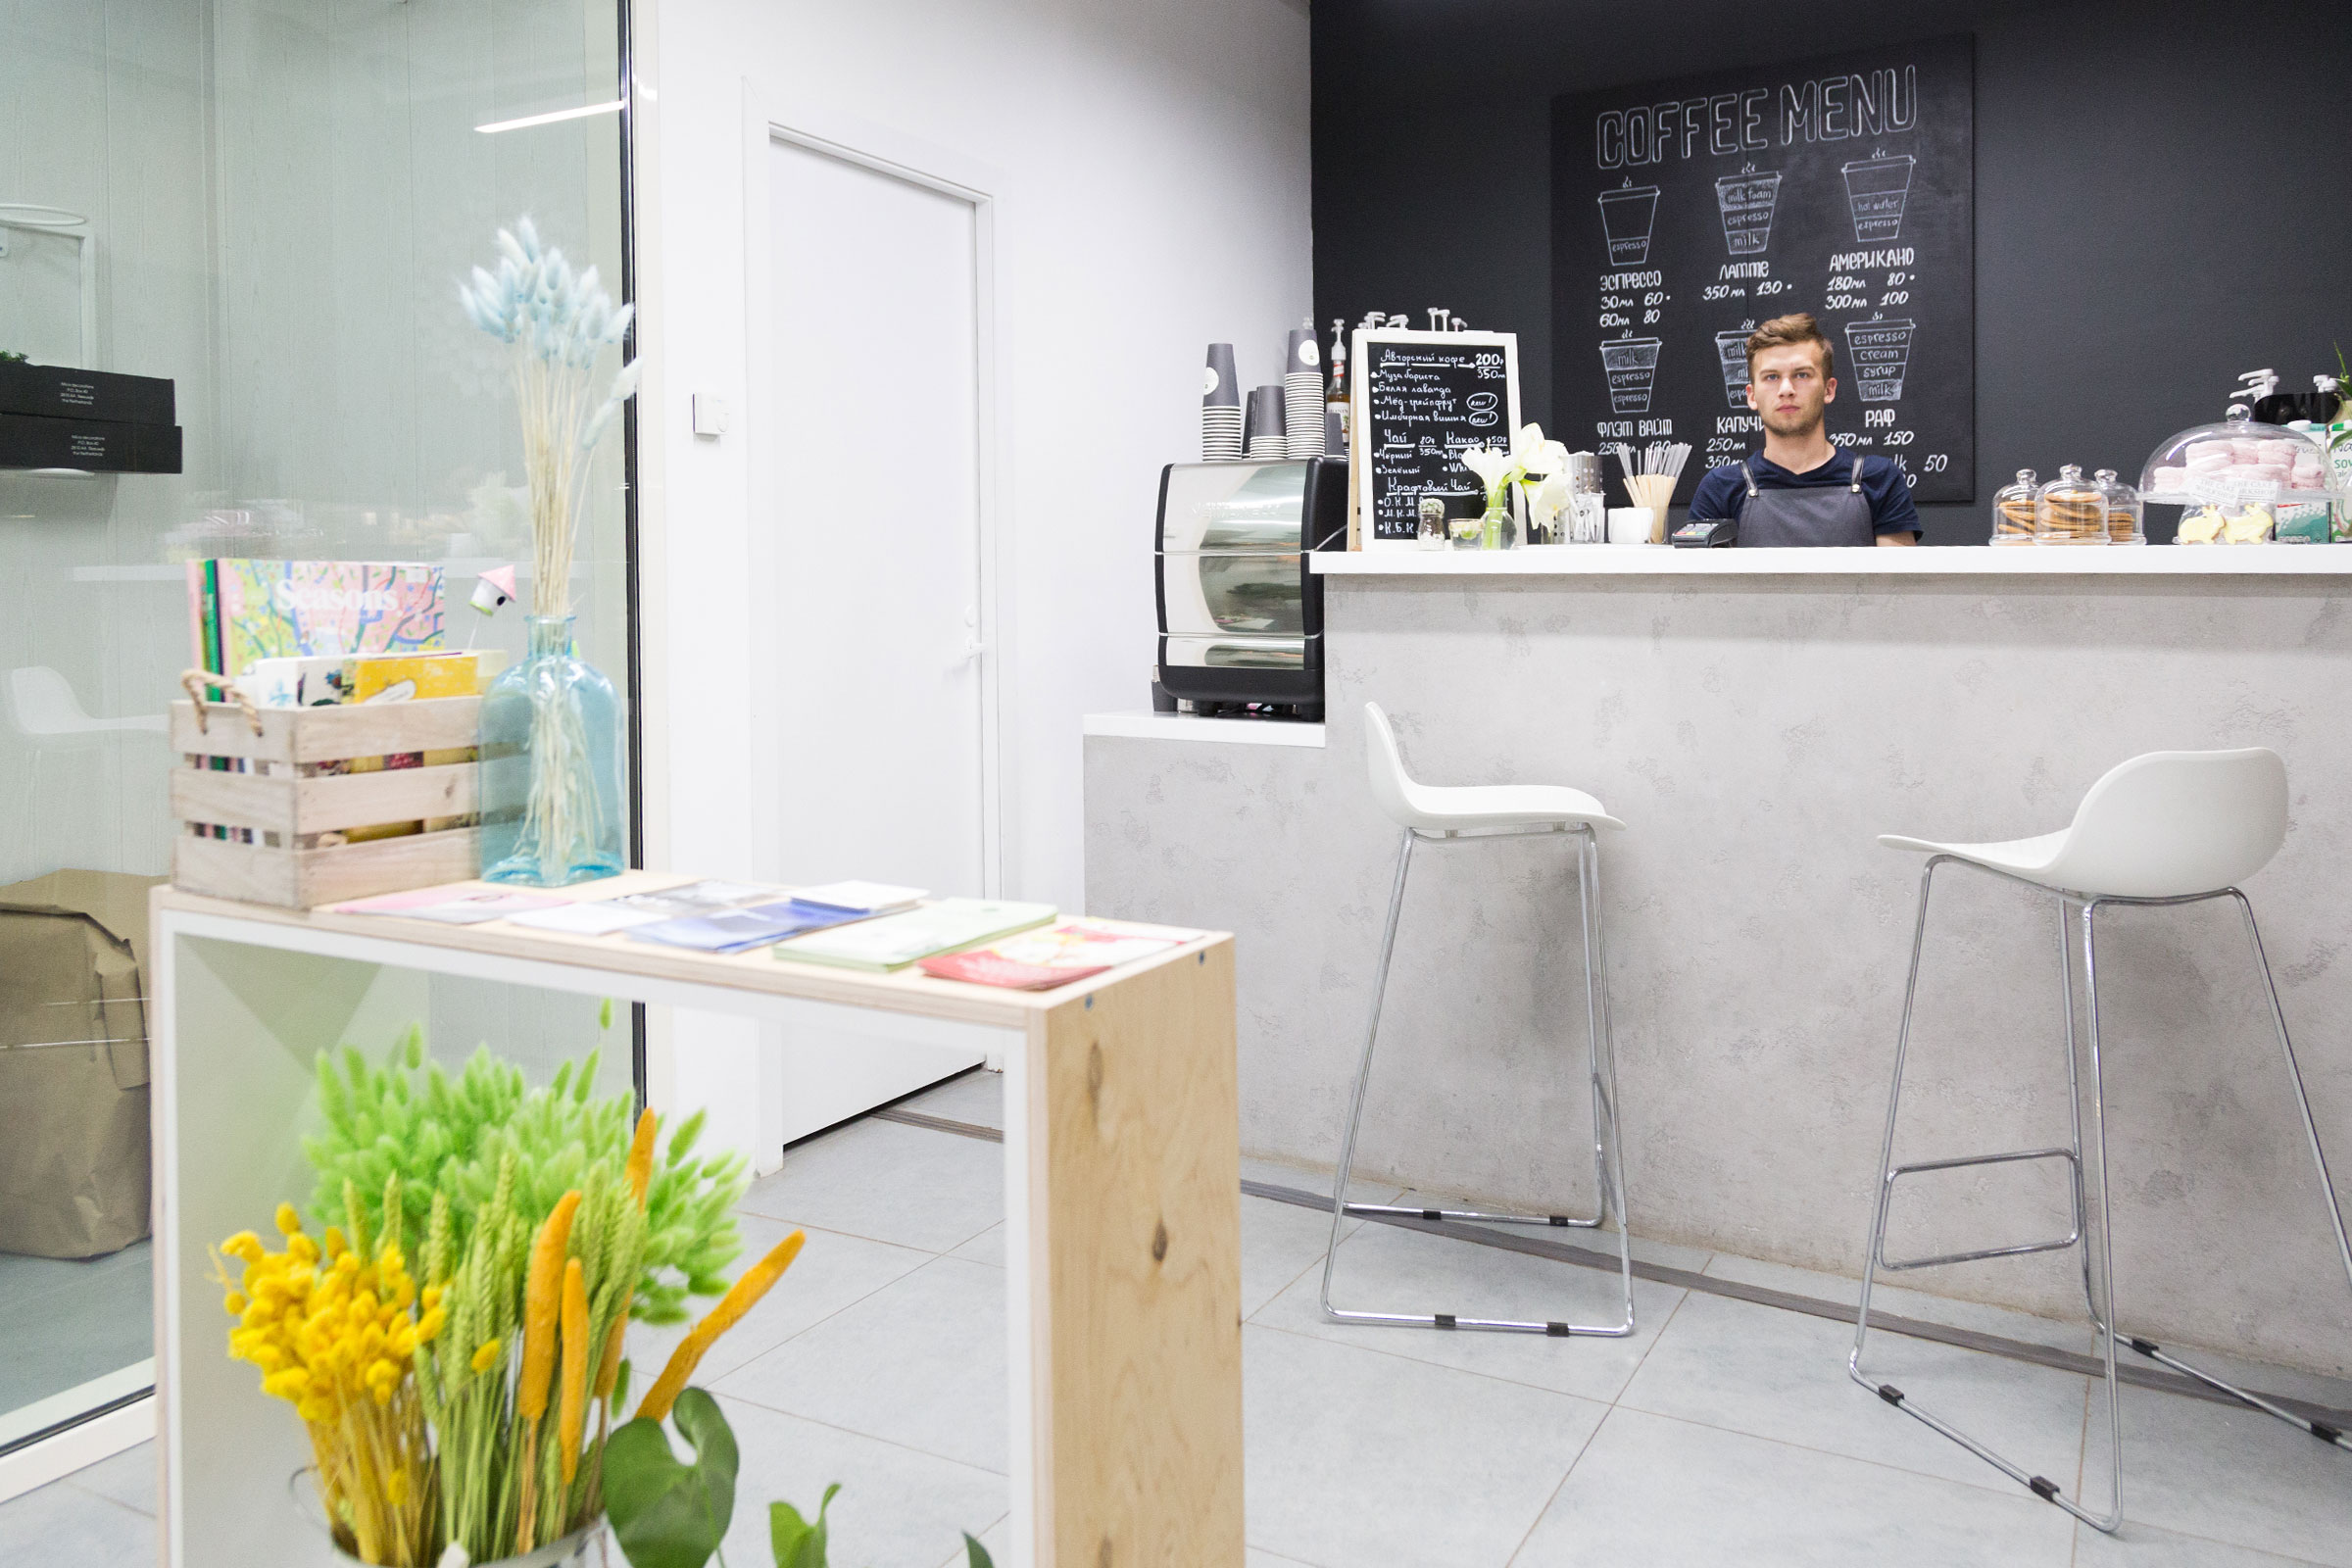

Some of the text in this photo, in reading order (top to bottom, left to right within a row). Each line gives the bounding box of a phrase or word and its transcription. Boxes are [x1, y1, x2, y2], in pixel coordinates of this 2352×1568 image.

[1597, 64, 1918, 170] COFFEE MENU
[1727, 212, 1769, 226] espresso
[1858, 219, 1898, 232] espresso
[1734, 232, 1760, 247] milk
[1612, 240, 1647, 255] espresso
[1880, 290, 1909, 306] 100
[1642, 309, 1661, 324] 80
[1854, 331, 1907, 345] espresso
[1380, 349, 1465, 368] Авторский кофе
[1617, 348, 1640, 368] milk
[1860, 348, 1899, 360] cream
[1611, 371, 1651, 386] espresso
[1863, 366, 1896, 378] syrup
[1868, 382, 1892, 396] milk
[1613, 393, 1648, 407] espresso
[1864, 408, 1896, 428] РАФ
[1384, 428, 1408, 443] Чай
[1446, 430, 1481, 444] Какао
[1883, 430, 1915, 445] 150
[1923, 454, 1948, 472] 50
[275, 578, 399, 611] Seasons
